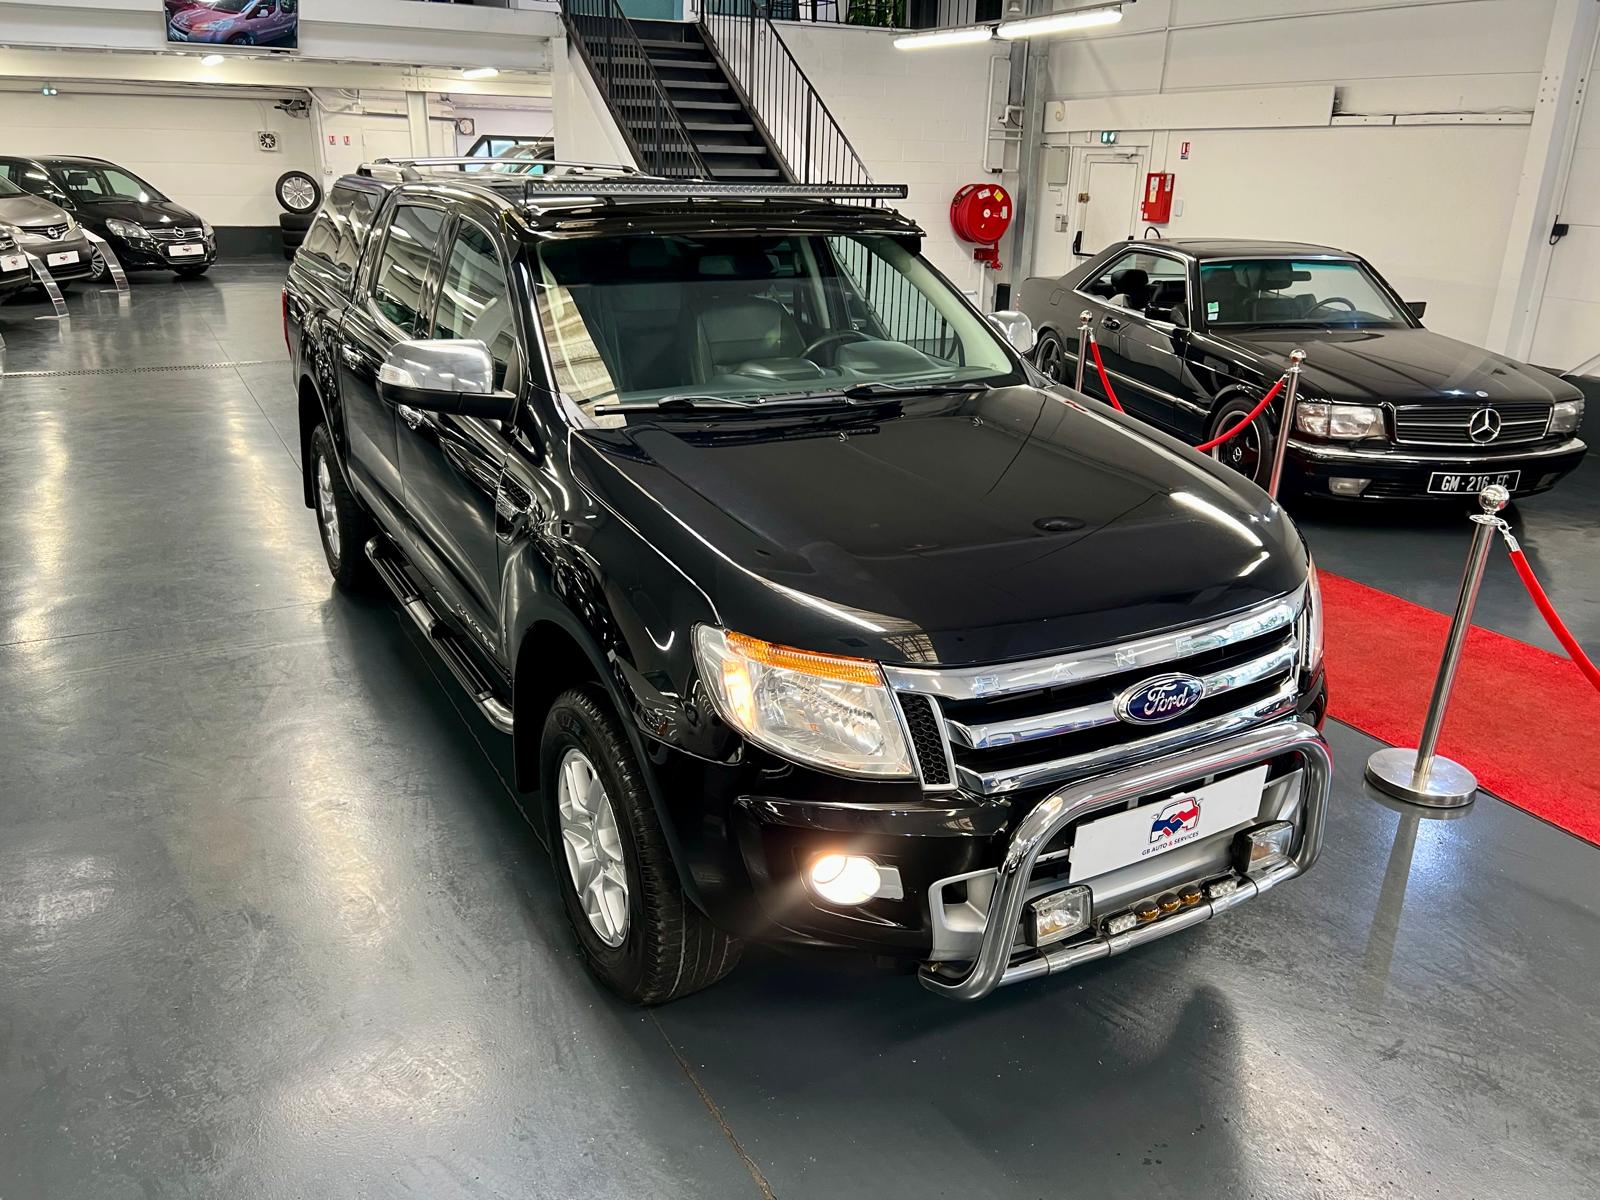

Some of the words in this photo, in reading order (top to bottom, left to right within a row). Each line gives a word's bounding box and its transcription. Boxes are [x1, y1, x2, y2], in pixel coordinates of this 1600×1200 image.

[1144, 683, 1189, 716] Ford
[1141, 848, 1151, 856] GB
[1151, 842, 1167, 852] AUTO
[1174, 831, 1199, 844] SERVICES
